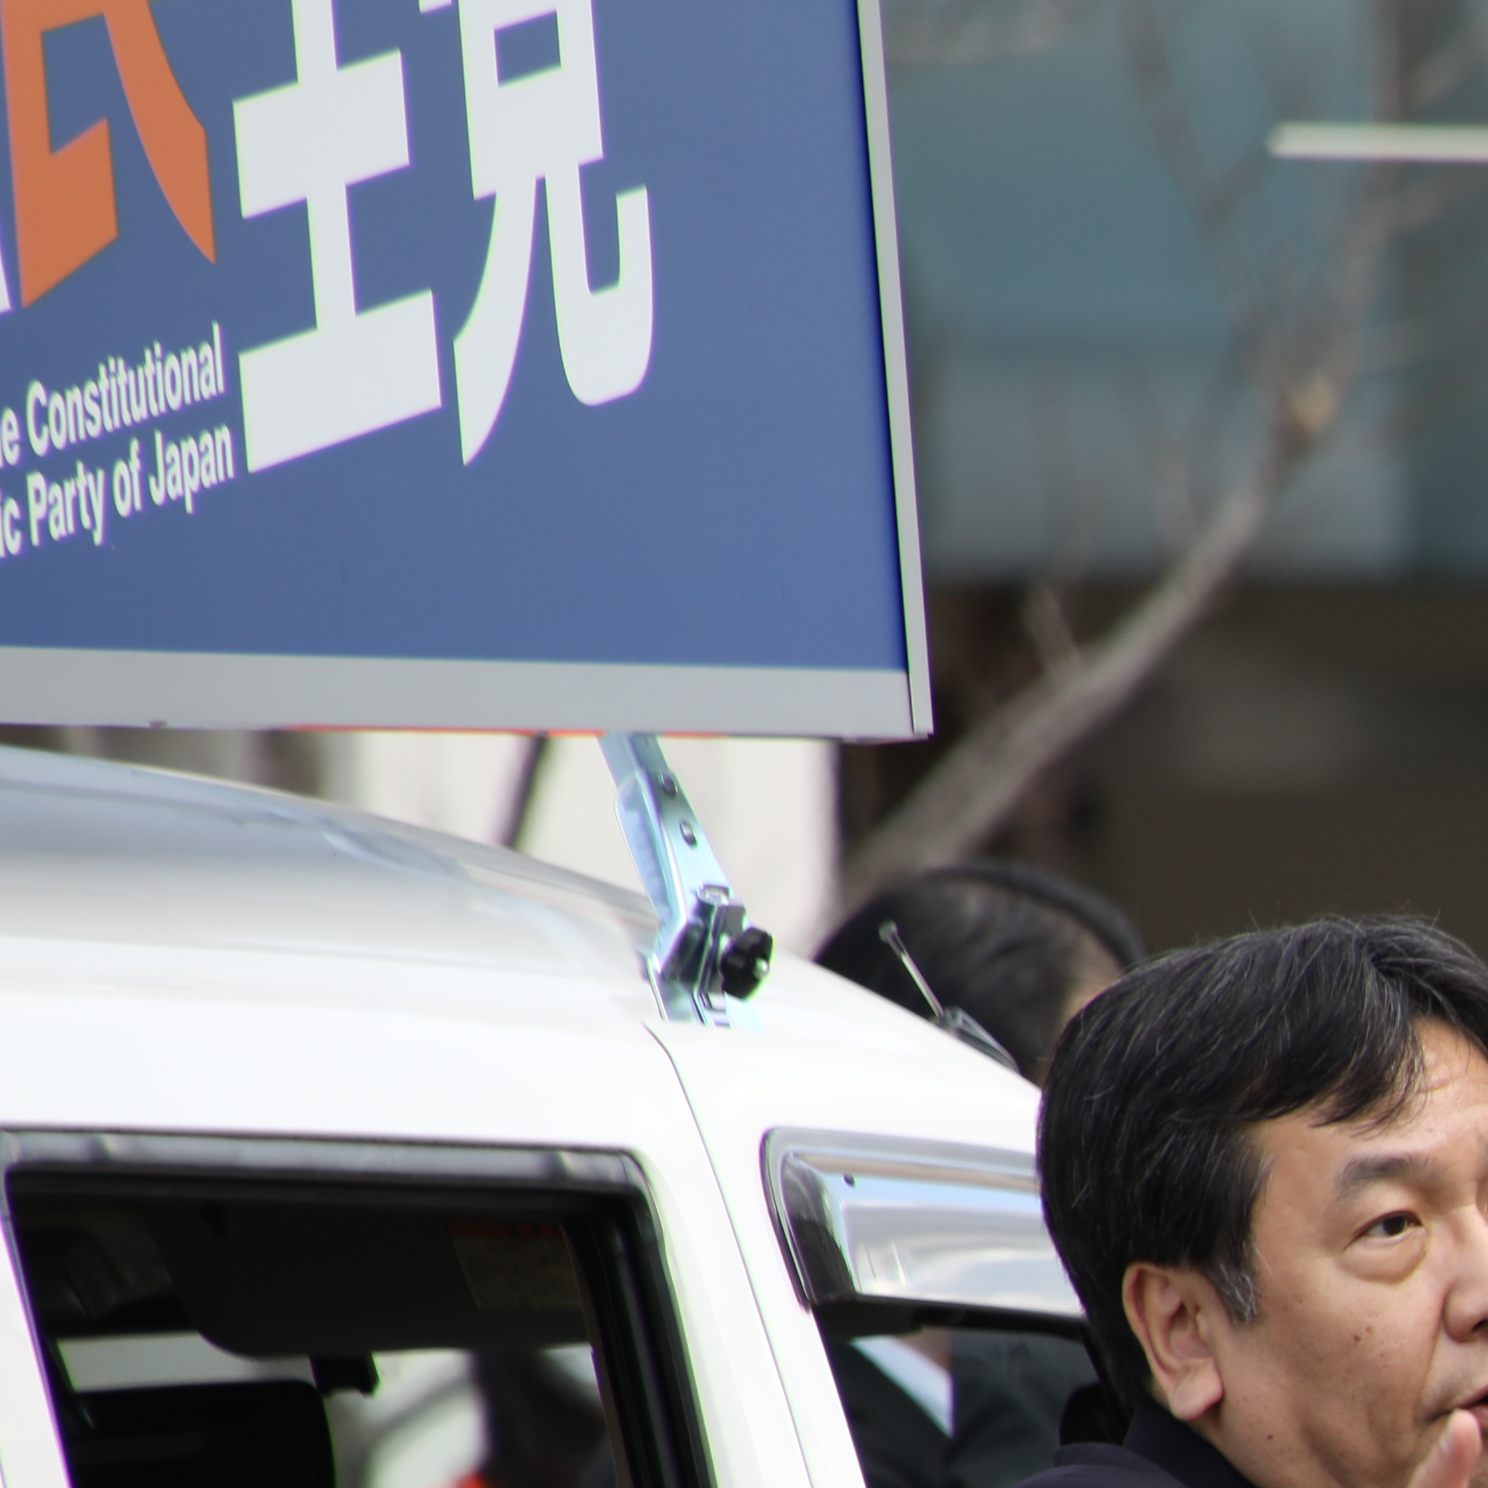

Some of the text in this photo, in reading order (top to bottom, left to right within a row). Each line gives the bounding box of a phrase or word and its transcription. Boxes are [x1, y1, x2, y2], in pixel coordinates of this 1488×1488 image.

[26, 319, 225, 456] Constitutional
[26, 470, 105, 547] Party
[113, 437, 143, 518] of
[149, 422, 235, 514] Japan
